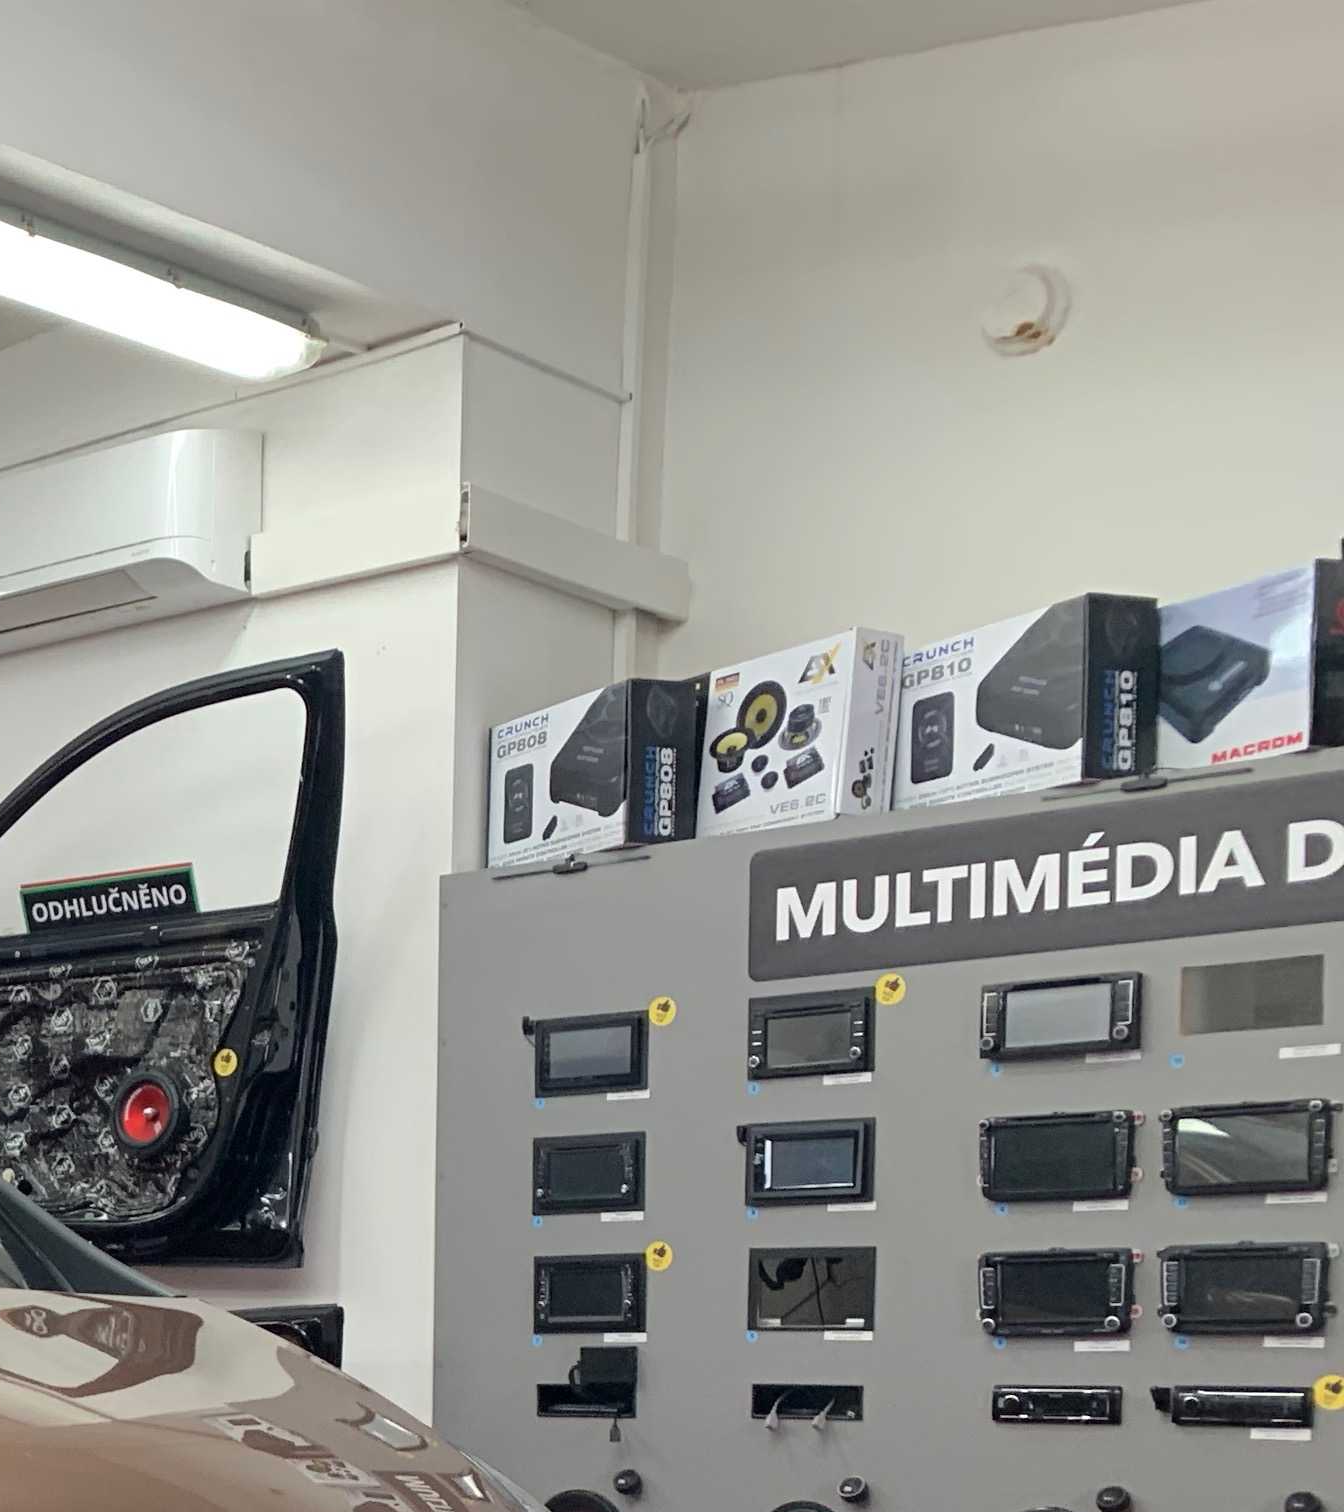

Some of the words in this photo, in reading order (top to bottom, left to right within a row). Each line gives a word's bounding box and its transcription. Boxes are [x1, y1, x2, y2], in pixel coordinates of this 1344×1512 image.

[902, 637, 975, 667] CRUNCH
[901, 657, 973, 689] GP810
[497, 713, 550, 740] CRUNCH
[1117, 669, 1137, 771] GP810
[497, 730, 548, 759] GP808
[1211, 731, 1304, 764] MACROM
[658, 747, 677, 837] GP808
[31, 883, 187, 923] ODHLUČNĚNO
[775, 831, 1265, 942] MULTIMÉDIA
